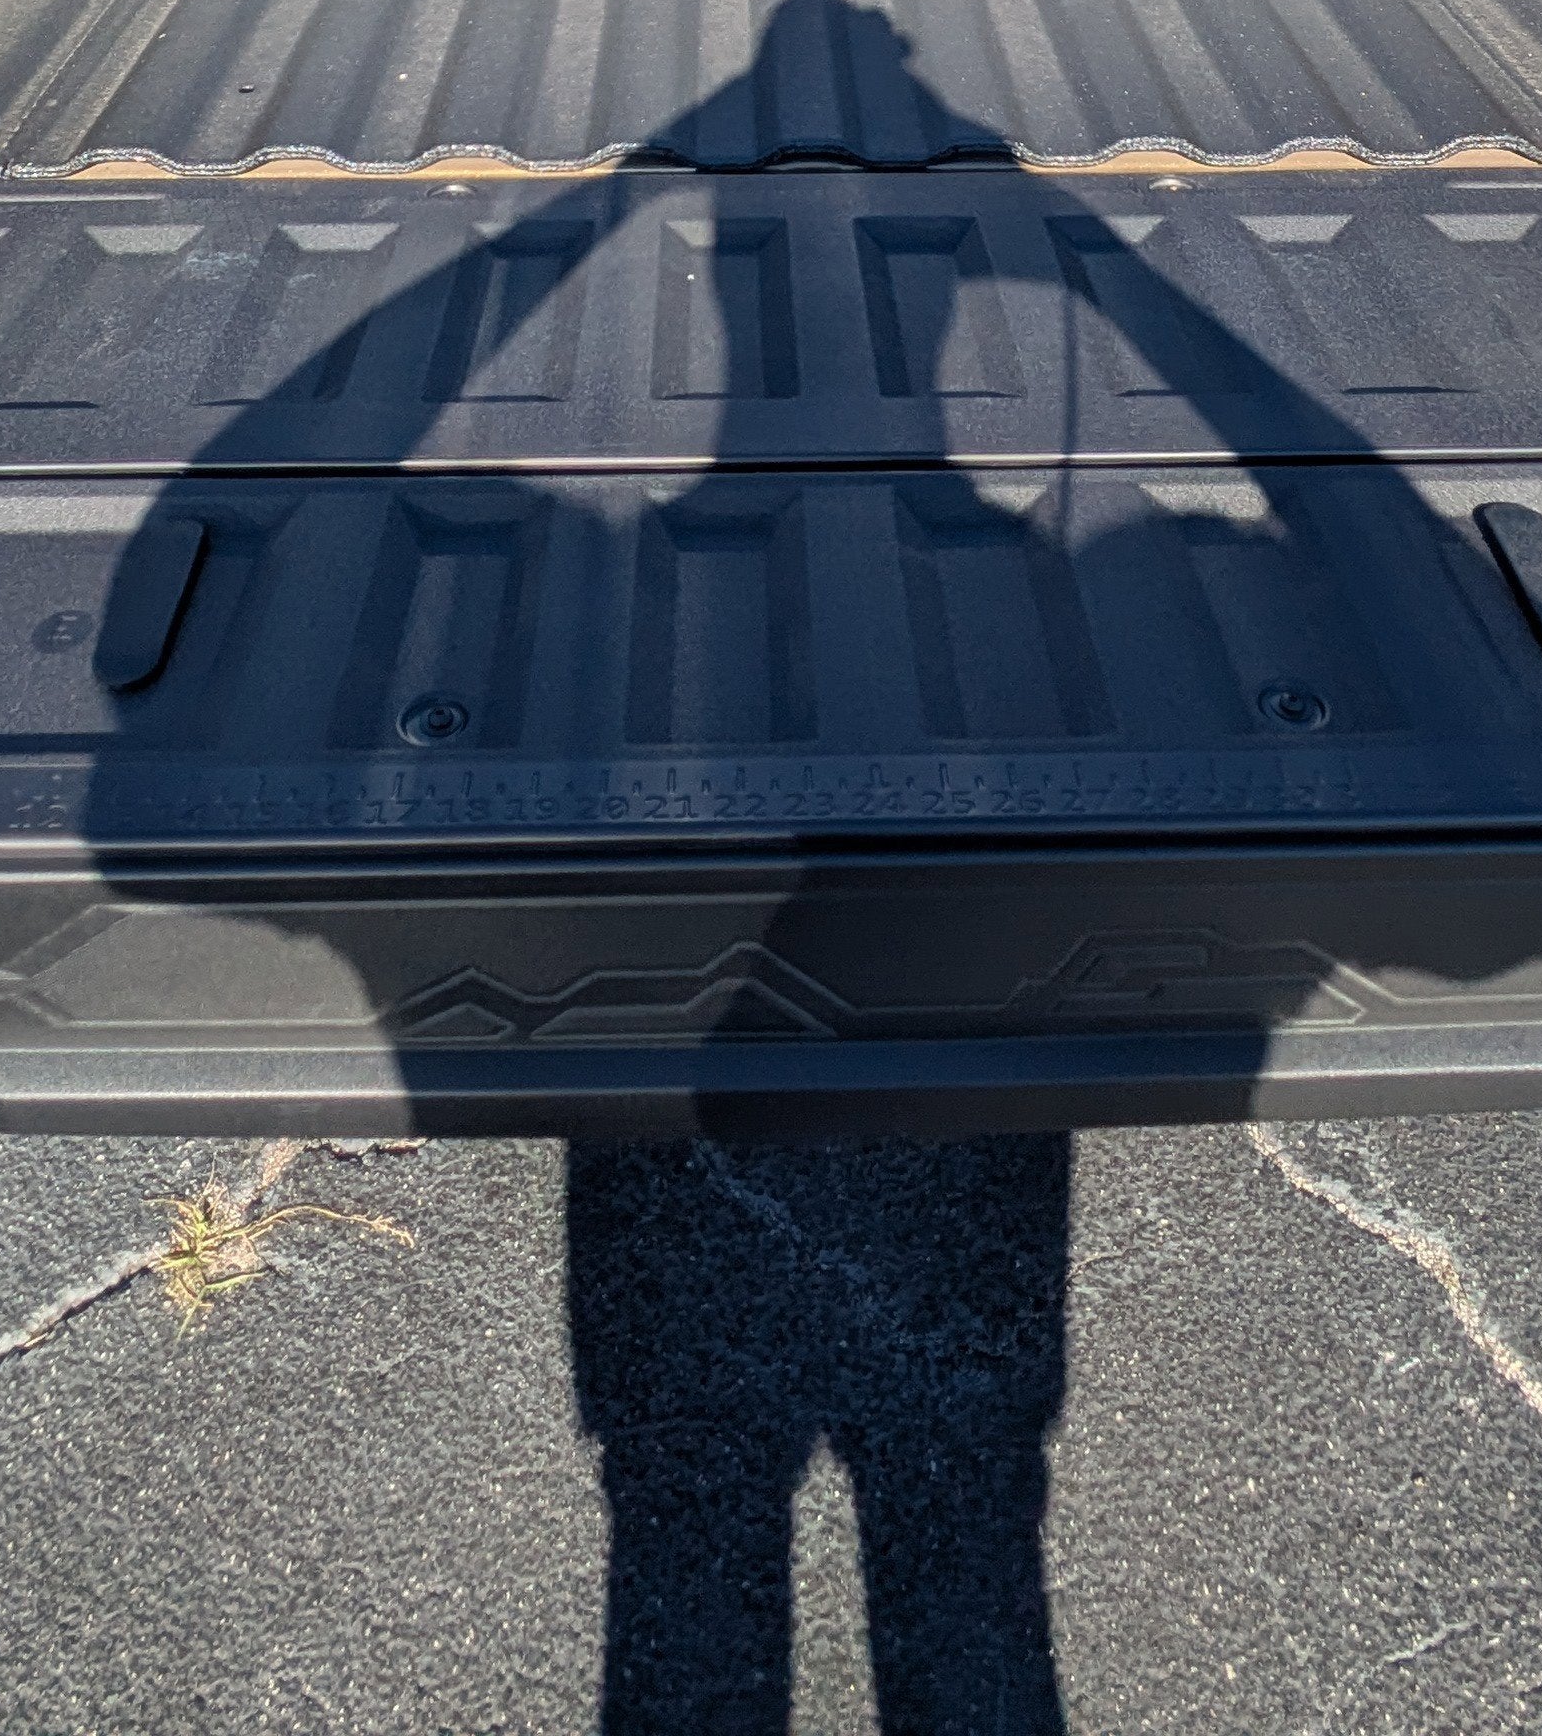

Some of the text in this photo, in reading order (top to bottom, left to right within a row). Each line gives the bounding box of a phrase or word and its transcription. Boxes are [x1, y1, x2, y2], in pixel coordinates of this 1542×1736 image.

[573, 795, 630, 820] 20
[643, 794, 699, 819] 21
[712, 793, 768, 817] 22
[782, 792, 835, 816] 23
[920, 790, 976, 814] 25
